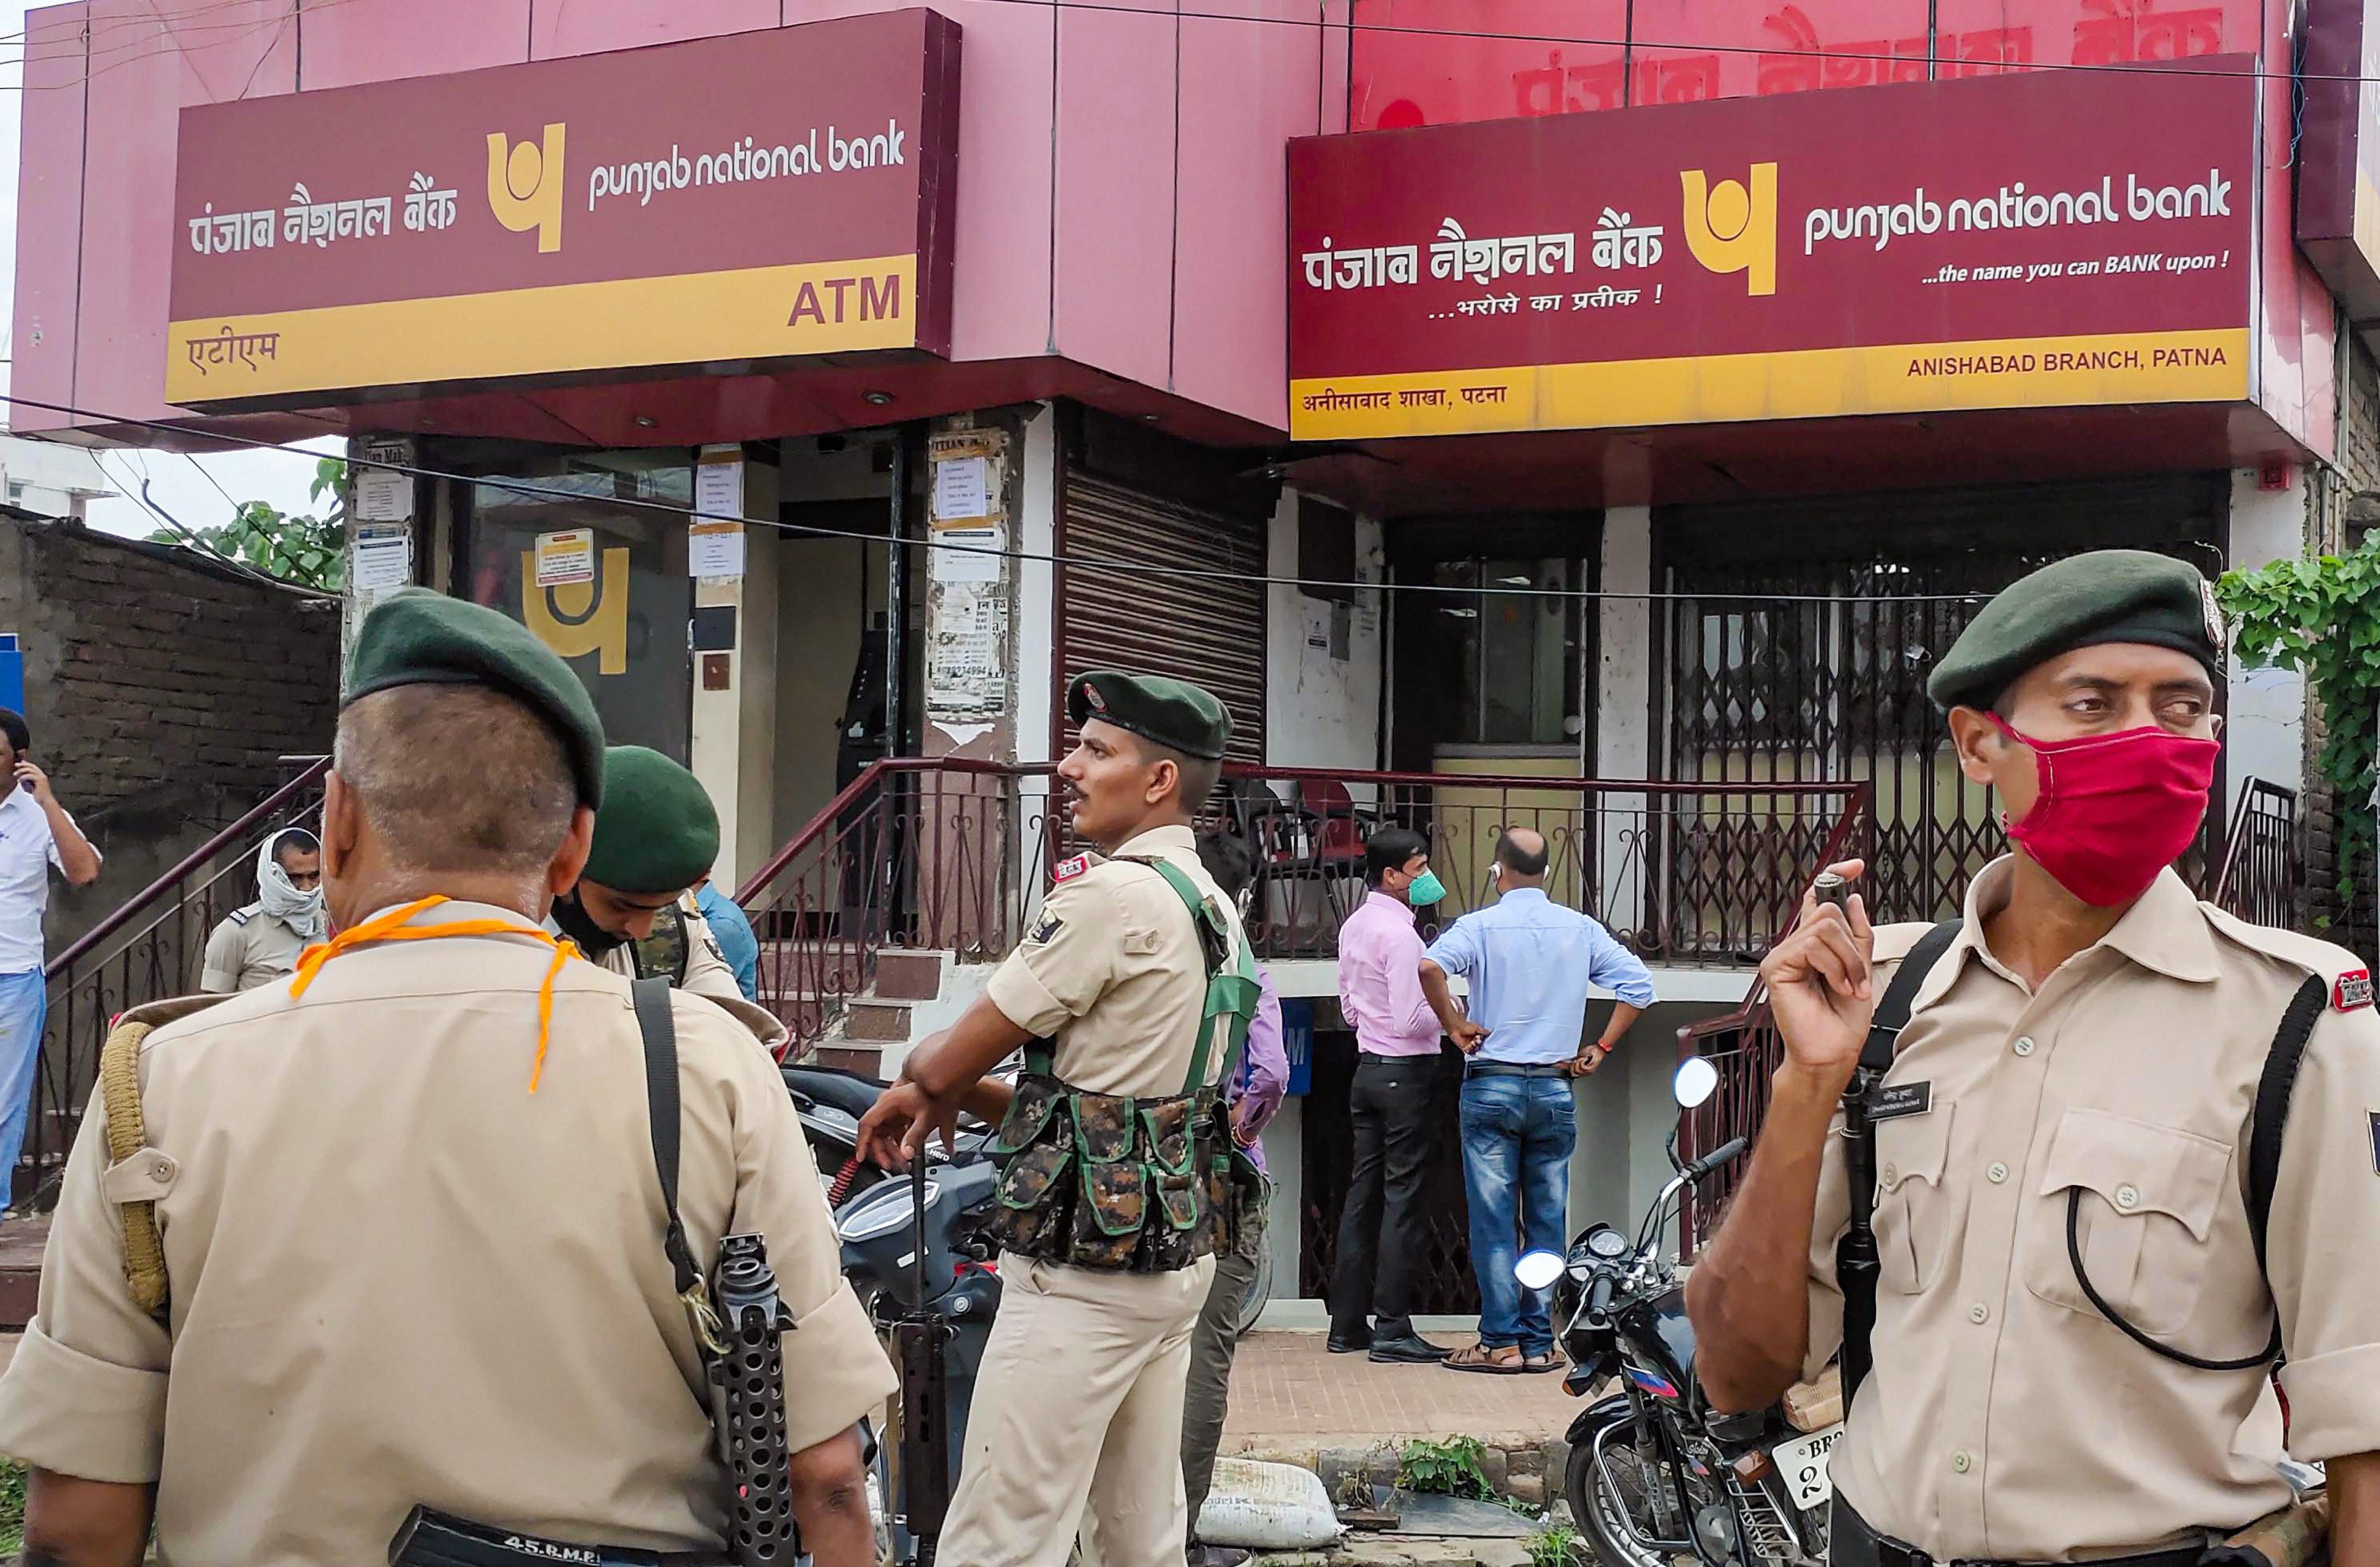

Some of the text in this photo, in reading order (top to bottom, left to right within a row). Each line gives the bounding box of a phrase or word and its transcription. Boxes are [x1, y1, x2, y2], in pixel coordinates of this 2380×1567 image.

[589, 118, 904, 212] punjab national bank
[188, 171, 458, 255] पंजाब नैशनल बैंक
[1805, 169, 2231, 255] punjab national bank
[1302, 207, 1664, 290] पंजाब नैशनल बैंक
[1922, 250, 2229, 284] ...the name you can BANK upon !
[787, 275, 899, 327] ATM
[1529, 294, 1563, 311] का
[1571, 285, 1641, 311] प्रतीक
[1655, 284, 1662, 304] !
[187, 325, 280, 374] एटीएम
[1907, 348, 2226, 377] ANISHABAD BRANCH, PATNA
[1460, 386, 1507, 405] पटना
[929, 1148, 950, 1161] Hero
